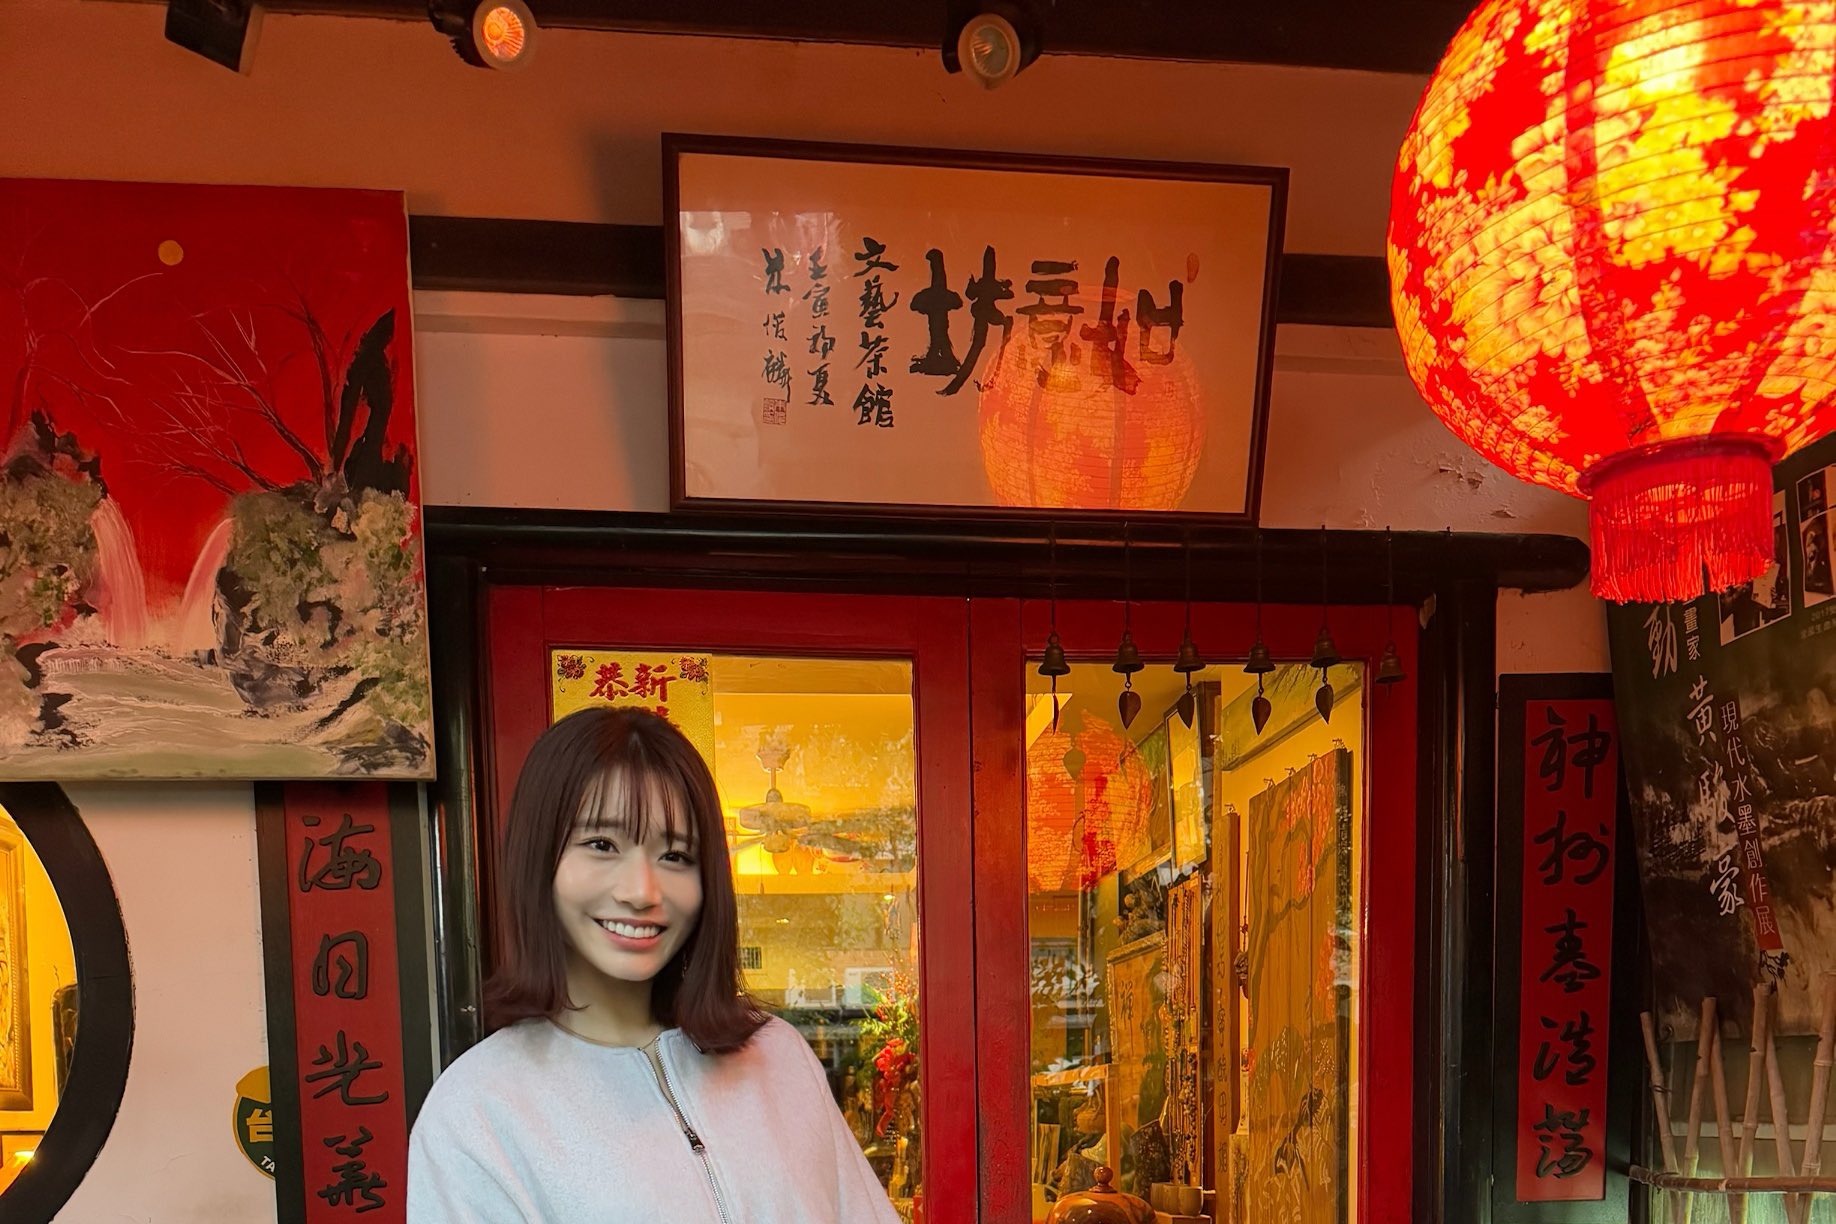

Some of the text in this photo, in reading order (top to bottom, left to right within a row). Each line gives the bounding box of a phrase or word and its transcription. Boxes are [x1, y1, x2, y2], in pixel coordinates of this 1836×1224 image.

[854, 236, 900, 428] 文藝茶館
[1720, 701, 1776, 936] 現代水墨創作展
